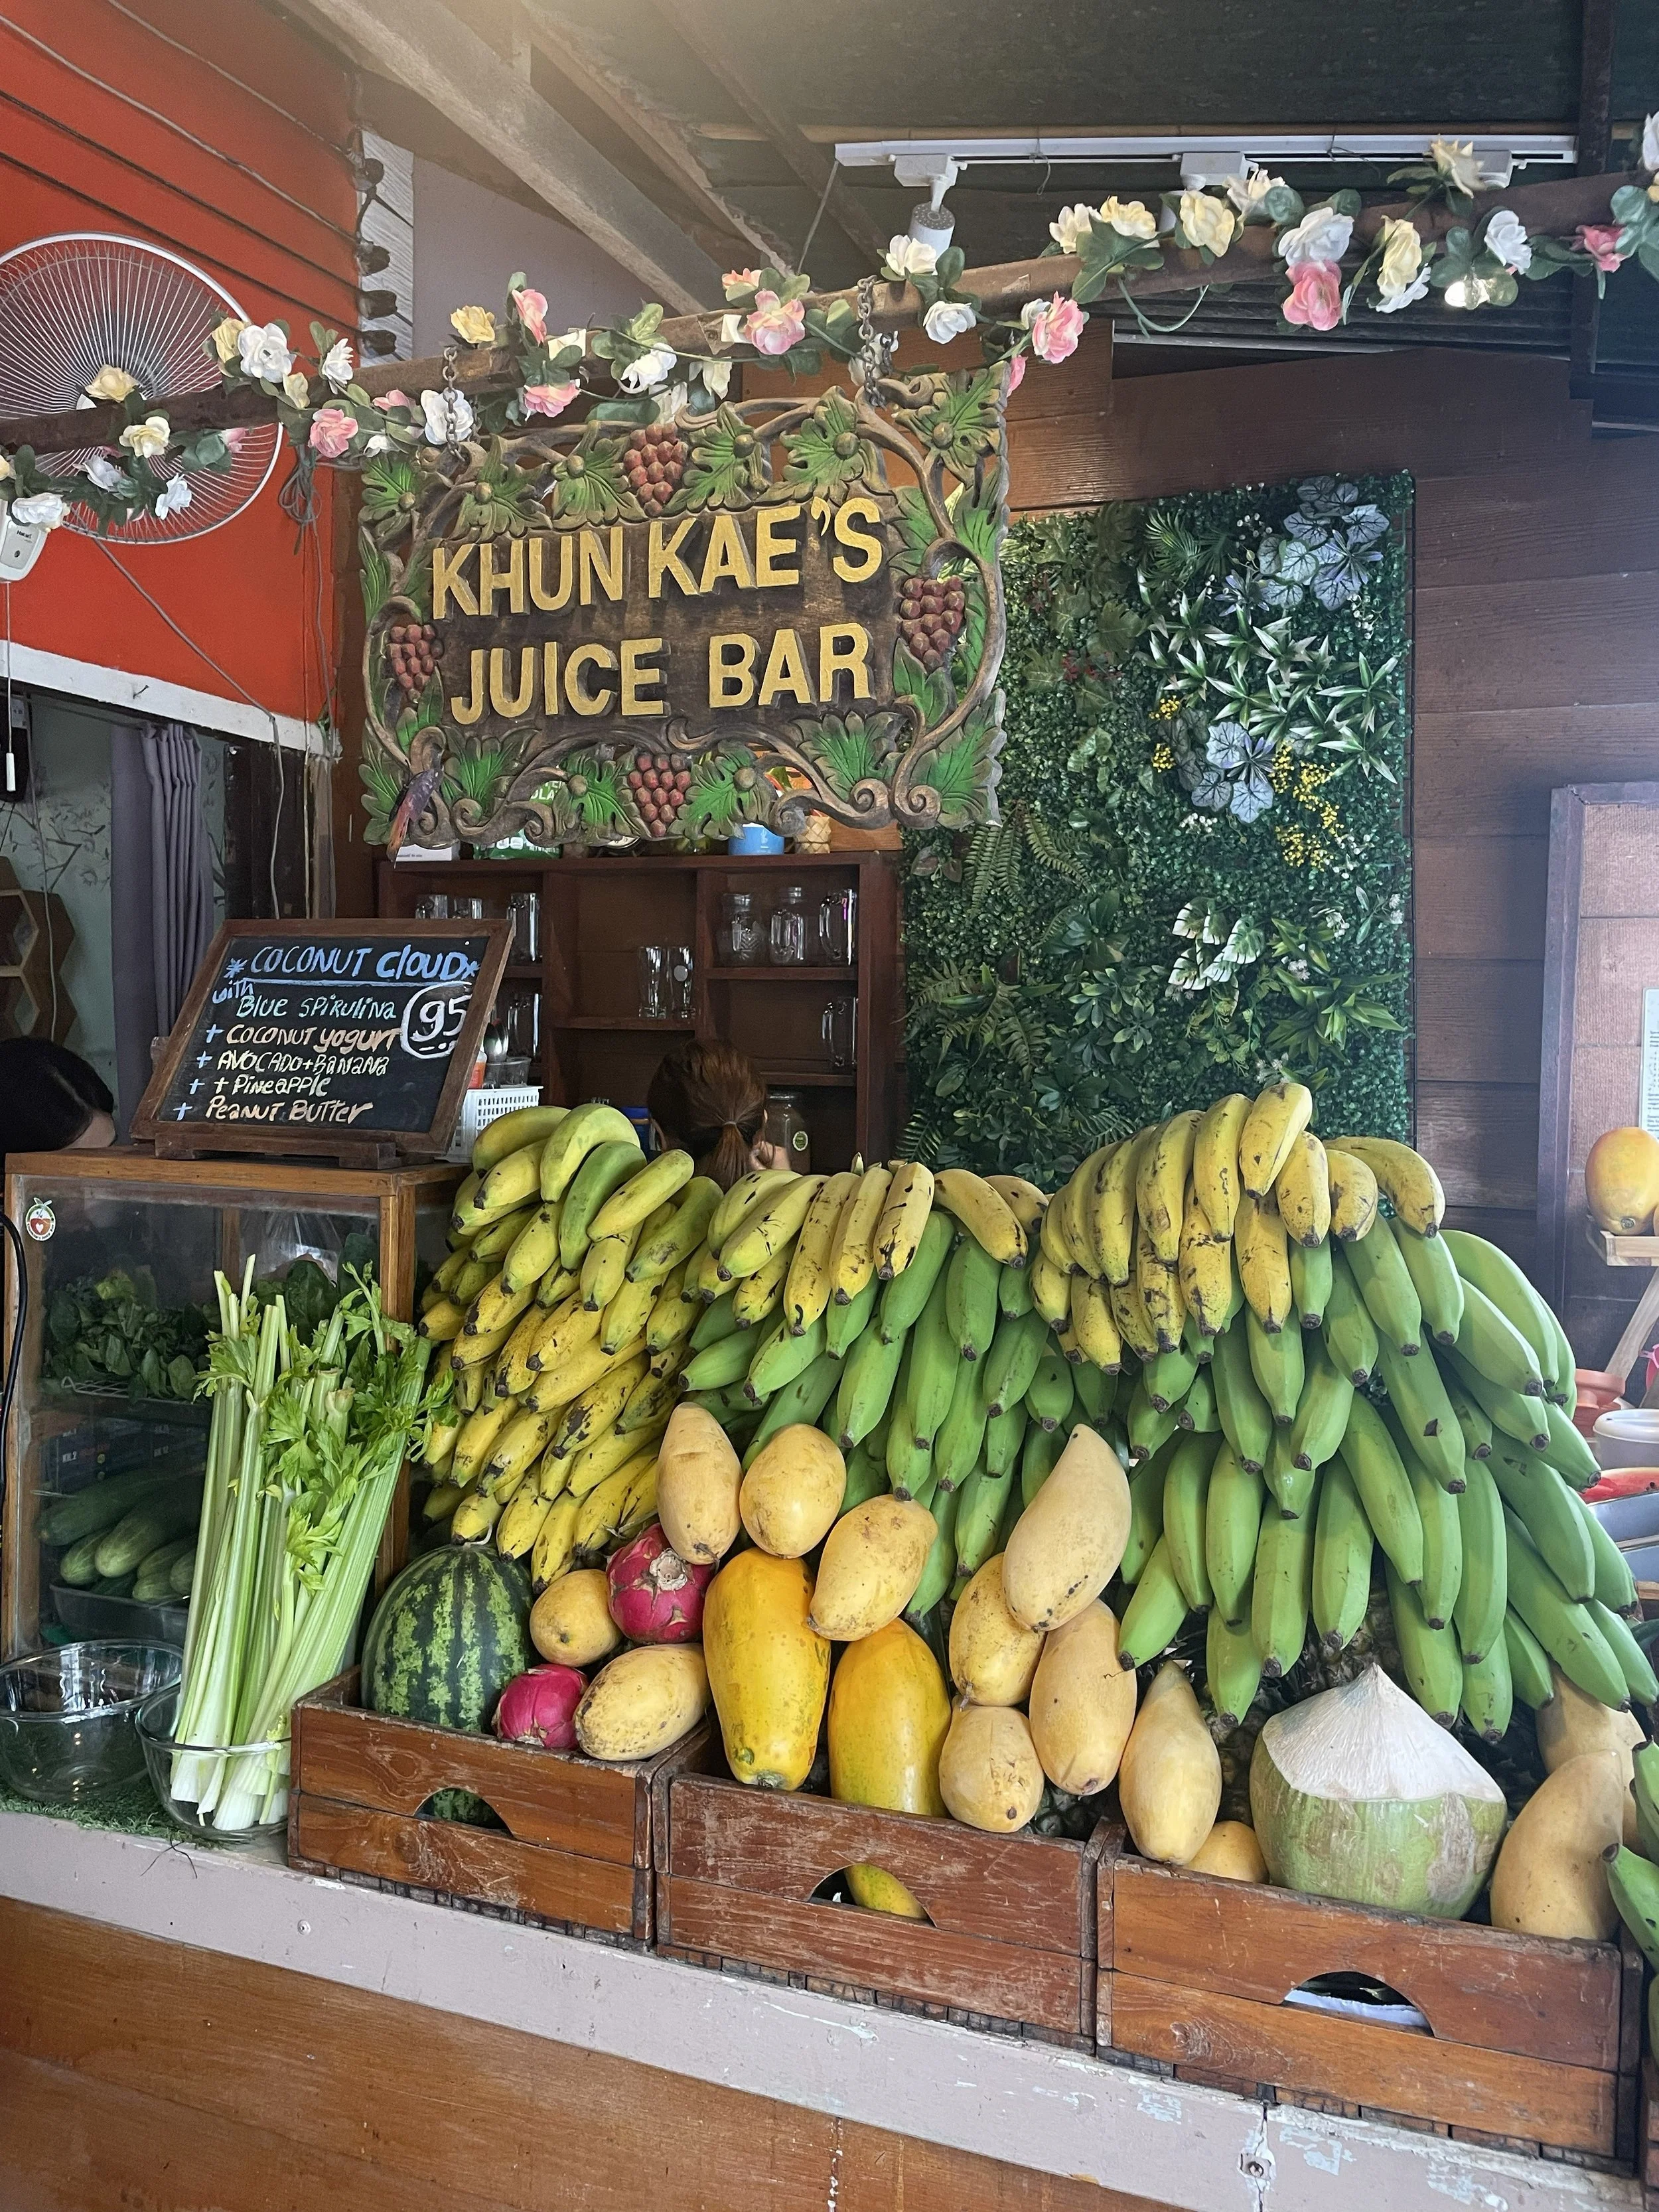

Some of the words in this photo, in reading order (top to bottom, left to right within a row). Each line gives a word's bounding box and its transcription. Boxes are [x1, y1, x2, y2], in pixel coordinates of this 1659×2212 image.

[432, 525, 624, 620] KHUN
[648, 497, 883, 597] KAE'S
[451, 637, 665, 725] JUICE
[708, 622, 873, 709] BAR
[251, 945, 374, 978] COCONUT
[226, 1024, 317, 1045] COCONUT
[409, 994, 472, 1043] 95
